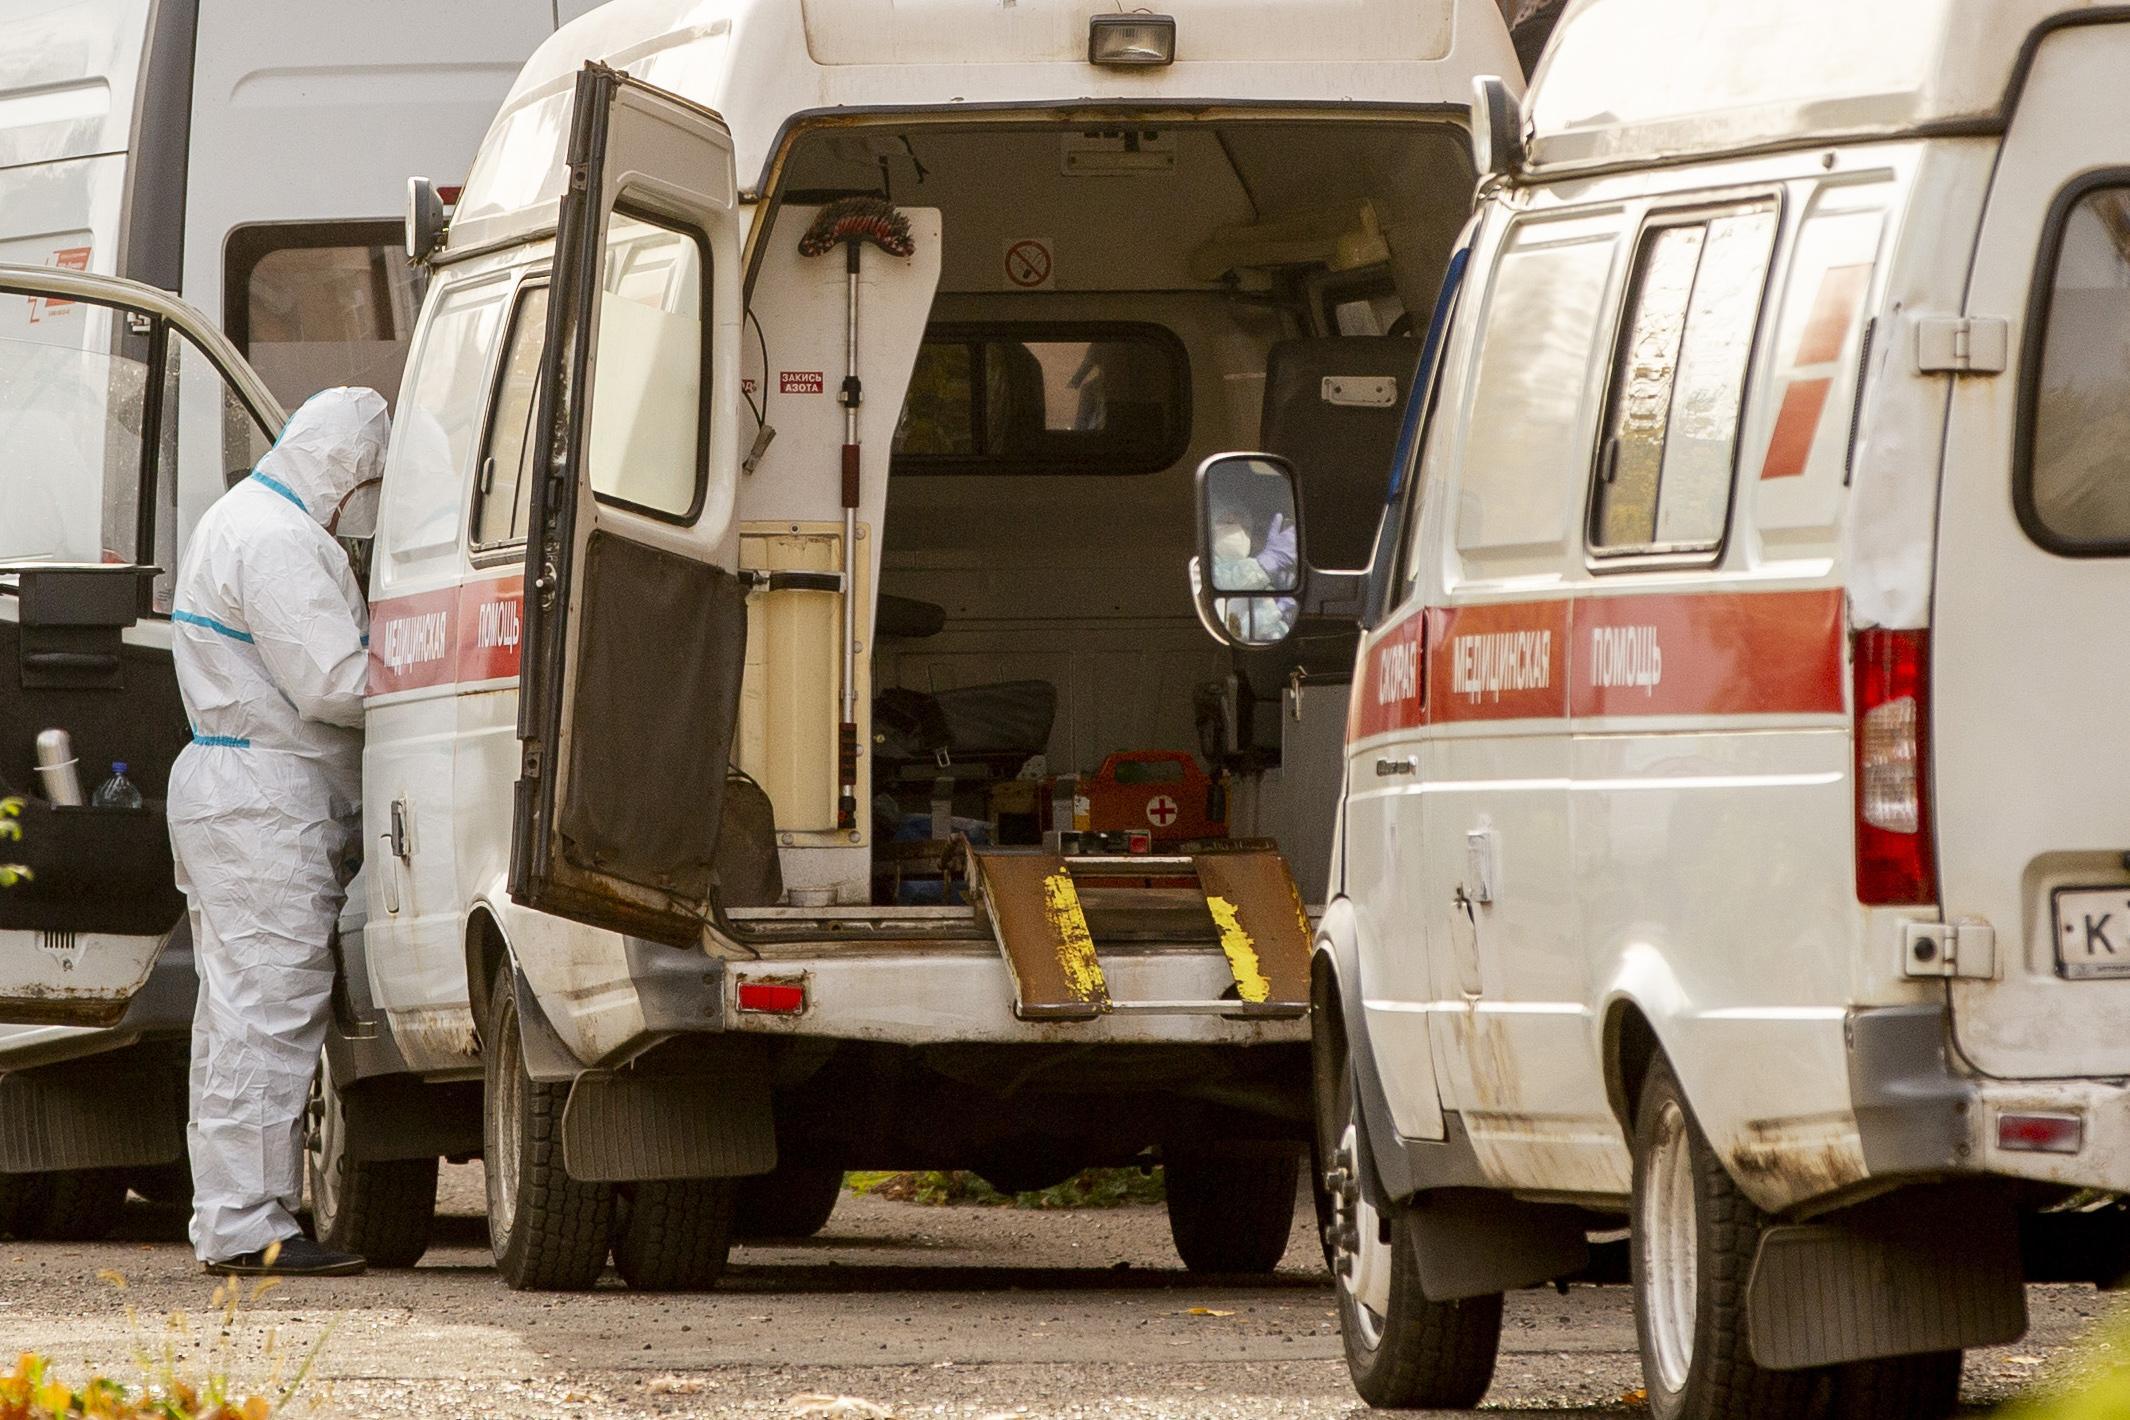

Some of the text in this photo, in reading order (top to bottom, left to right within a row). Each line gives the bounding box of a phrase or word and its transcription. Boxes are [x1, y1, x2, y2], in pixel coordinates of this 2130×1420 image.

[782, 373, 822, 382] ЗАКИСЬ
[785, 383, 819, 392] АЗОТА
[384, 600, 520, 676] МЕДИЦИНСКАЯ ПОМОЩЬ
[1454, 630, 1551, 704] МЕДИЦИНСКАЯ
[1592, 625, 1661, 697] ПОМОЩЬ
